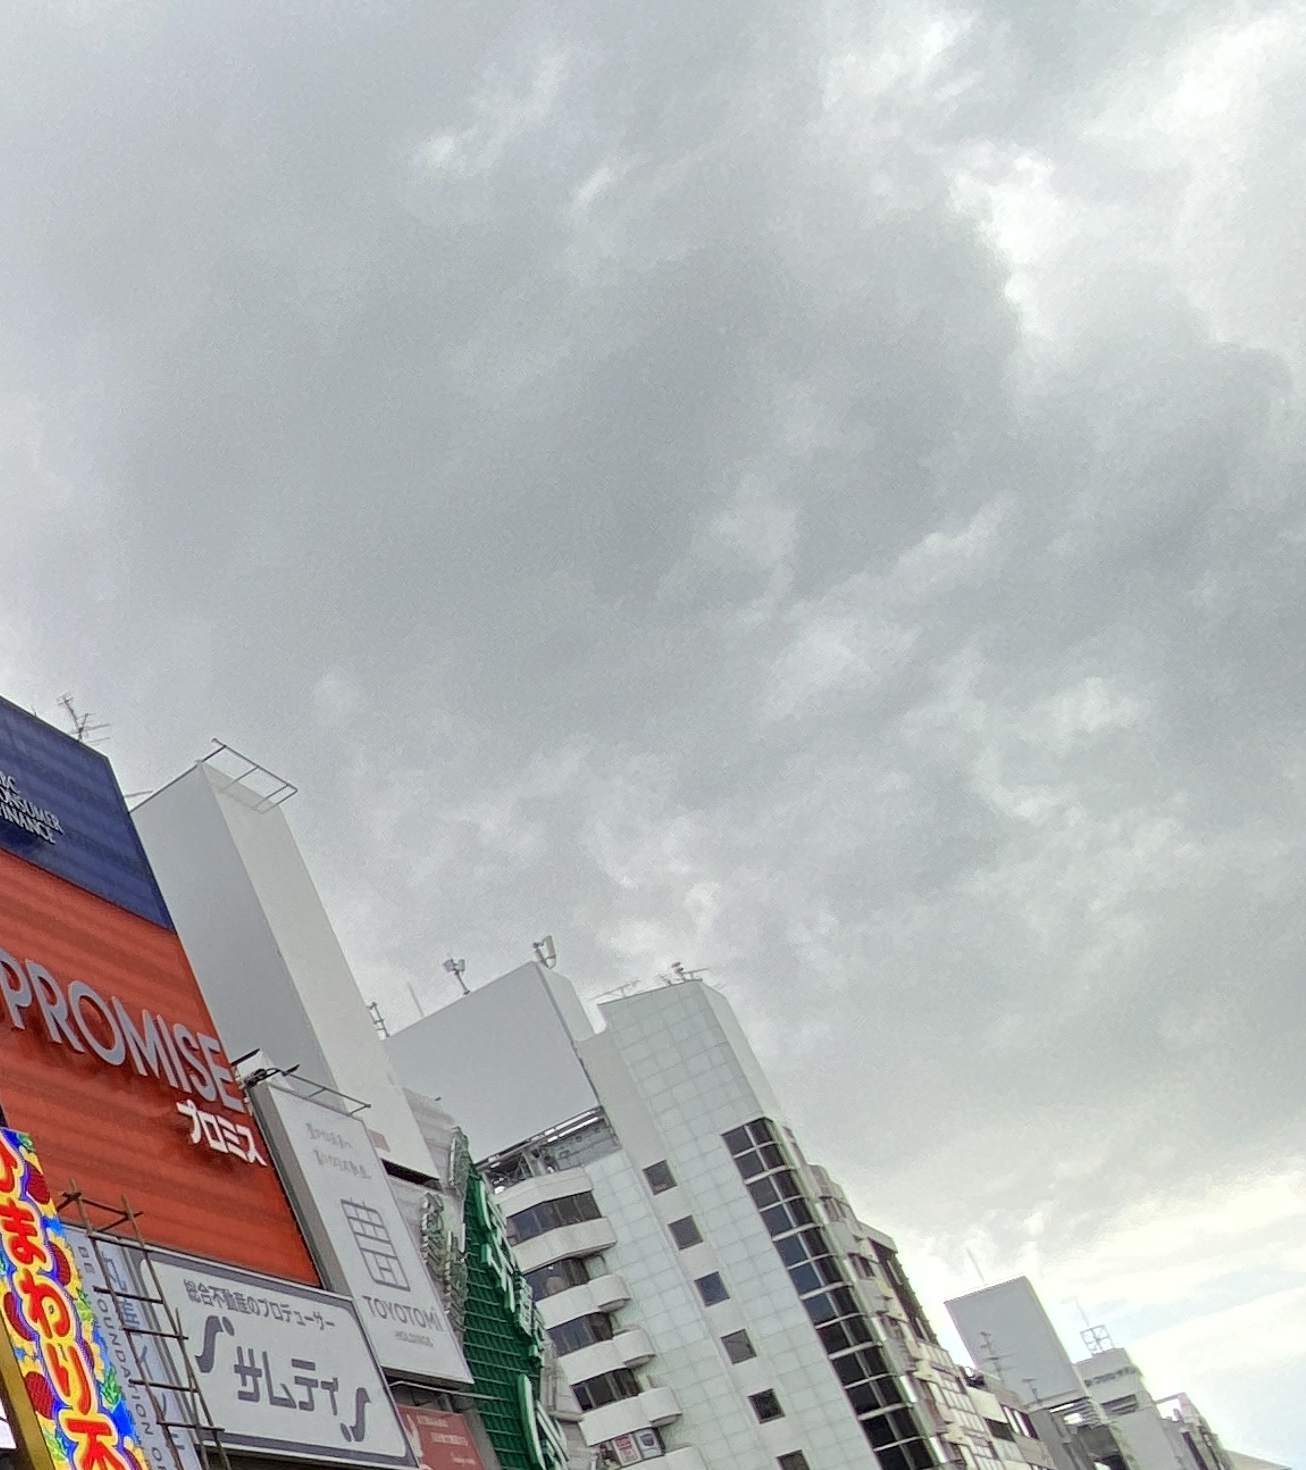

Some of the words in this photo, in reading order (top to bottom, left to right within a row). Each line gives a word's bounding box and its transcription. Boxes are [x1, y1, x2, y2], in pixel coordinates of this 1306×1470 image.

[175, 1097, 267, 1168] プロミス
[362, 1294, 444, 1333] TOYOTOMI
[233, 1345, 340, 1417] サムティ
